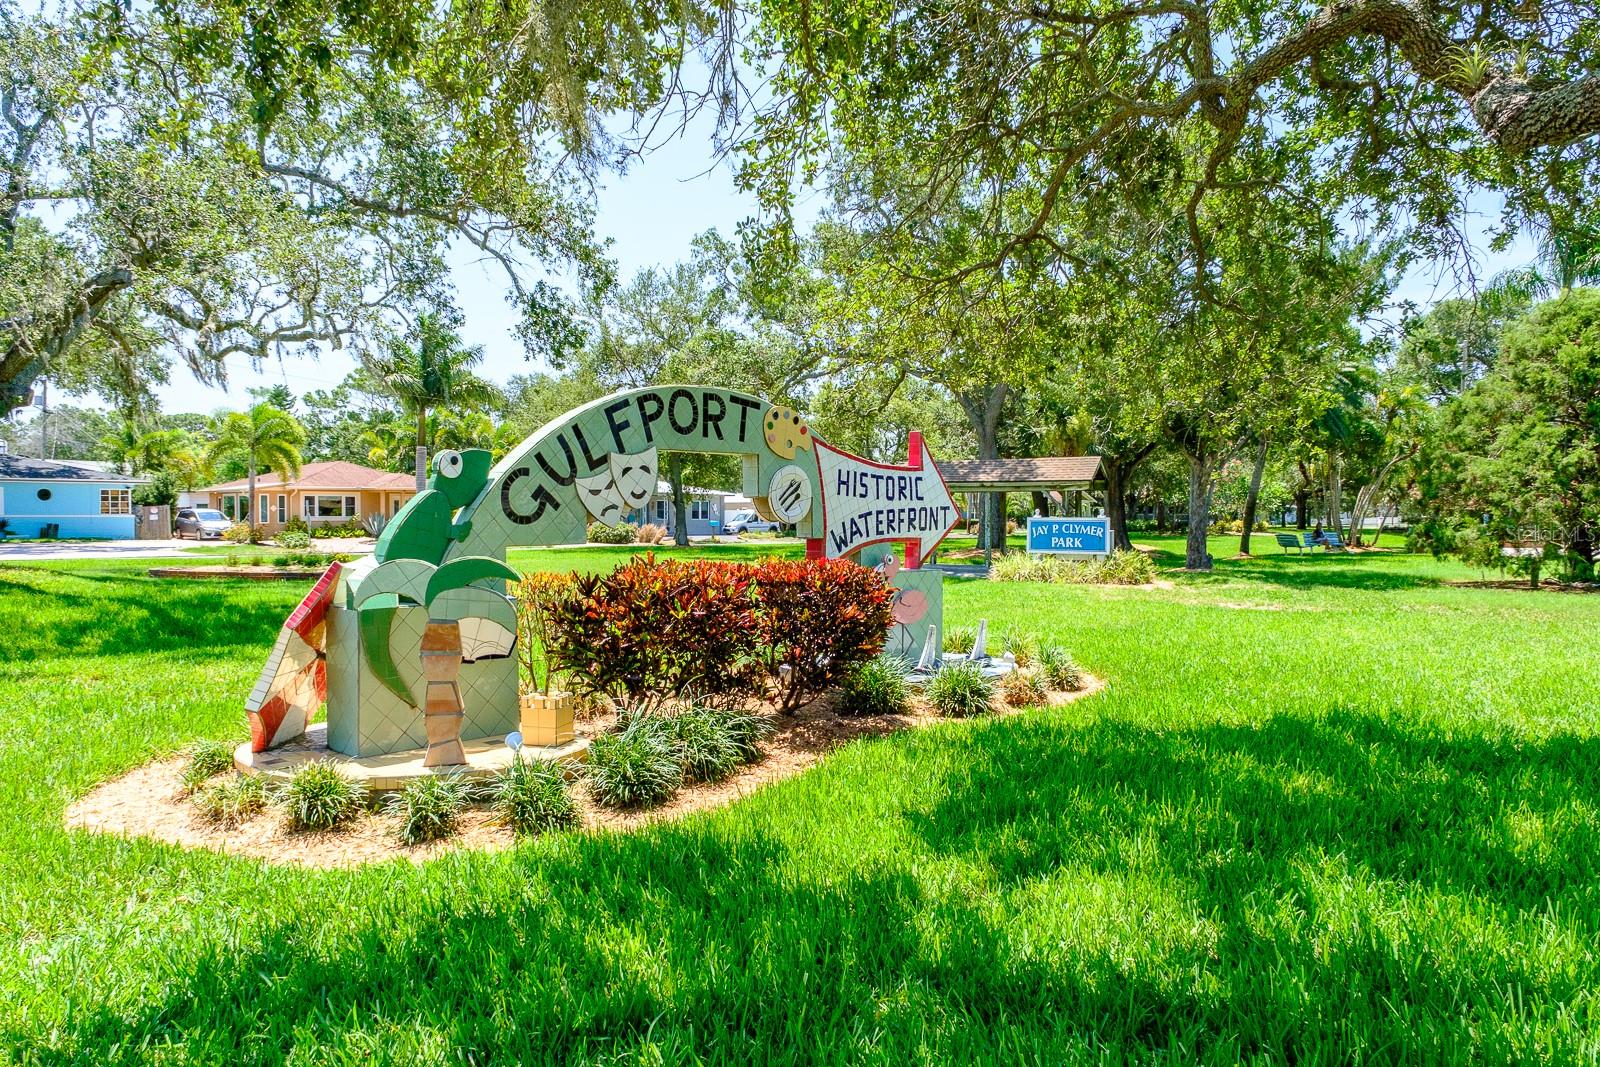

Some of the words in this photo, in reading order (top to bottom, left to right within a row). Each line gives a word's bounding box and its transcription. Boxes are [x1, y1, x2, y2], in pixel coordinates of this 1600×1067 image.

[500, 389, 760, 525] GULFPORT
[837, 469, 924, 501] HISTORIC
[830, 505, 950, 553] WATERFRONT
[1032, 525, 1049, 538] JAY
[1052, 523, 1059, 534] P.
[1062, 523, 1104, 538] CLYMER
[1051, 536, 1083, 548] PARK
